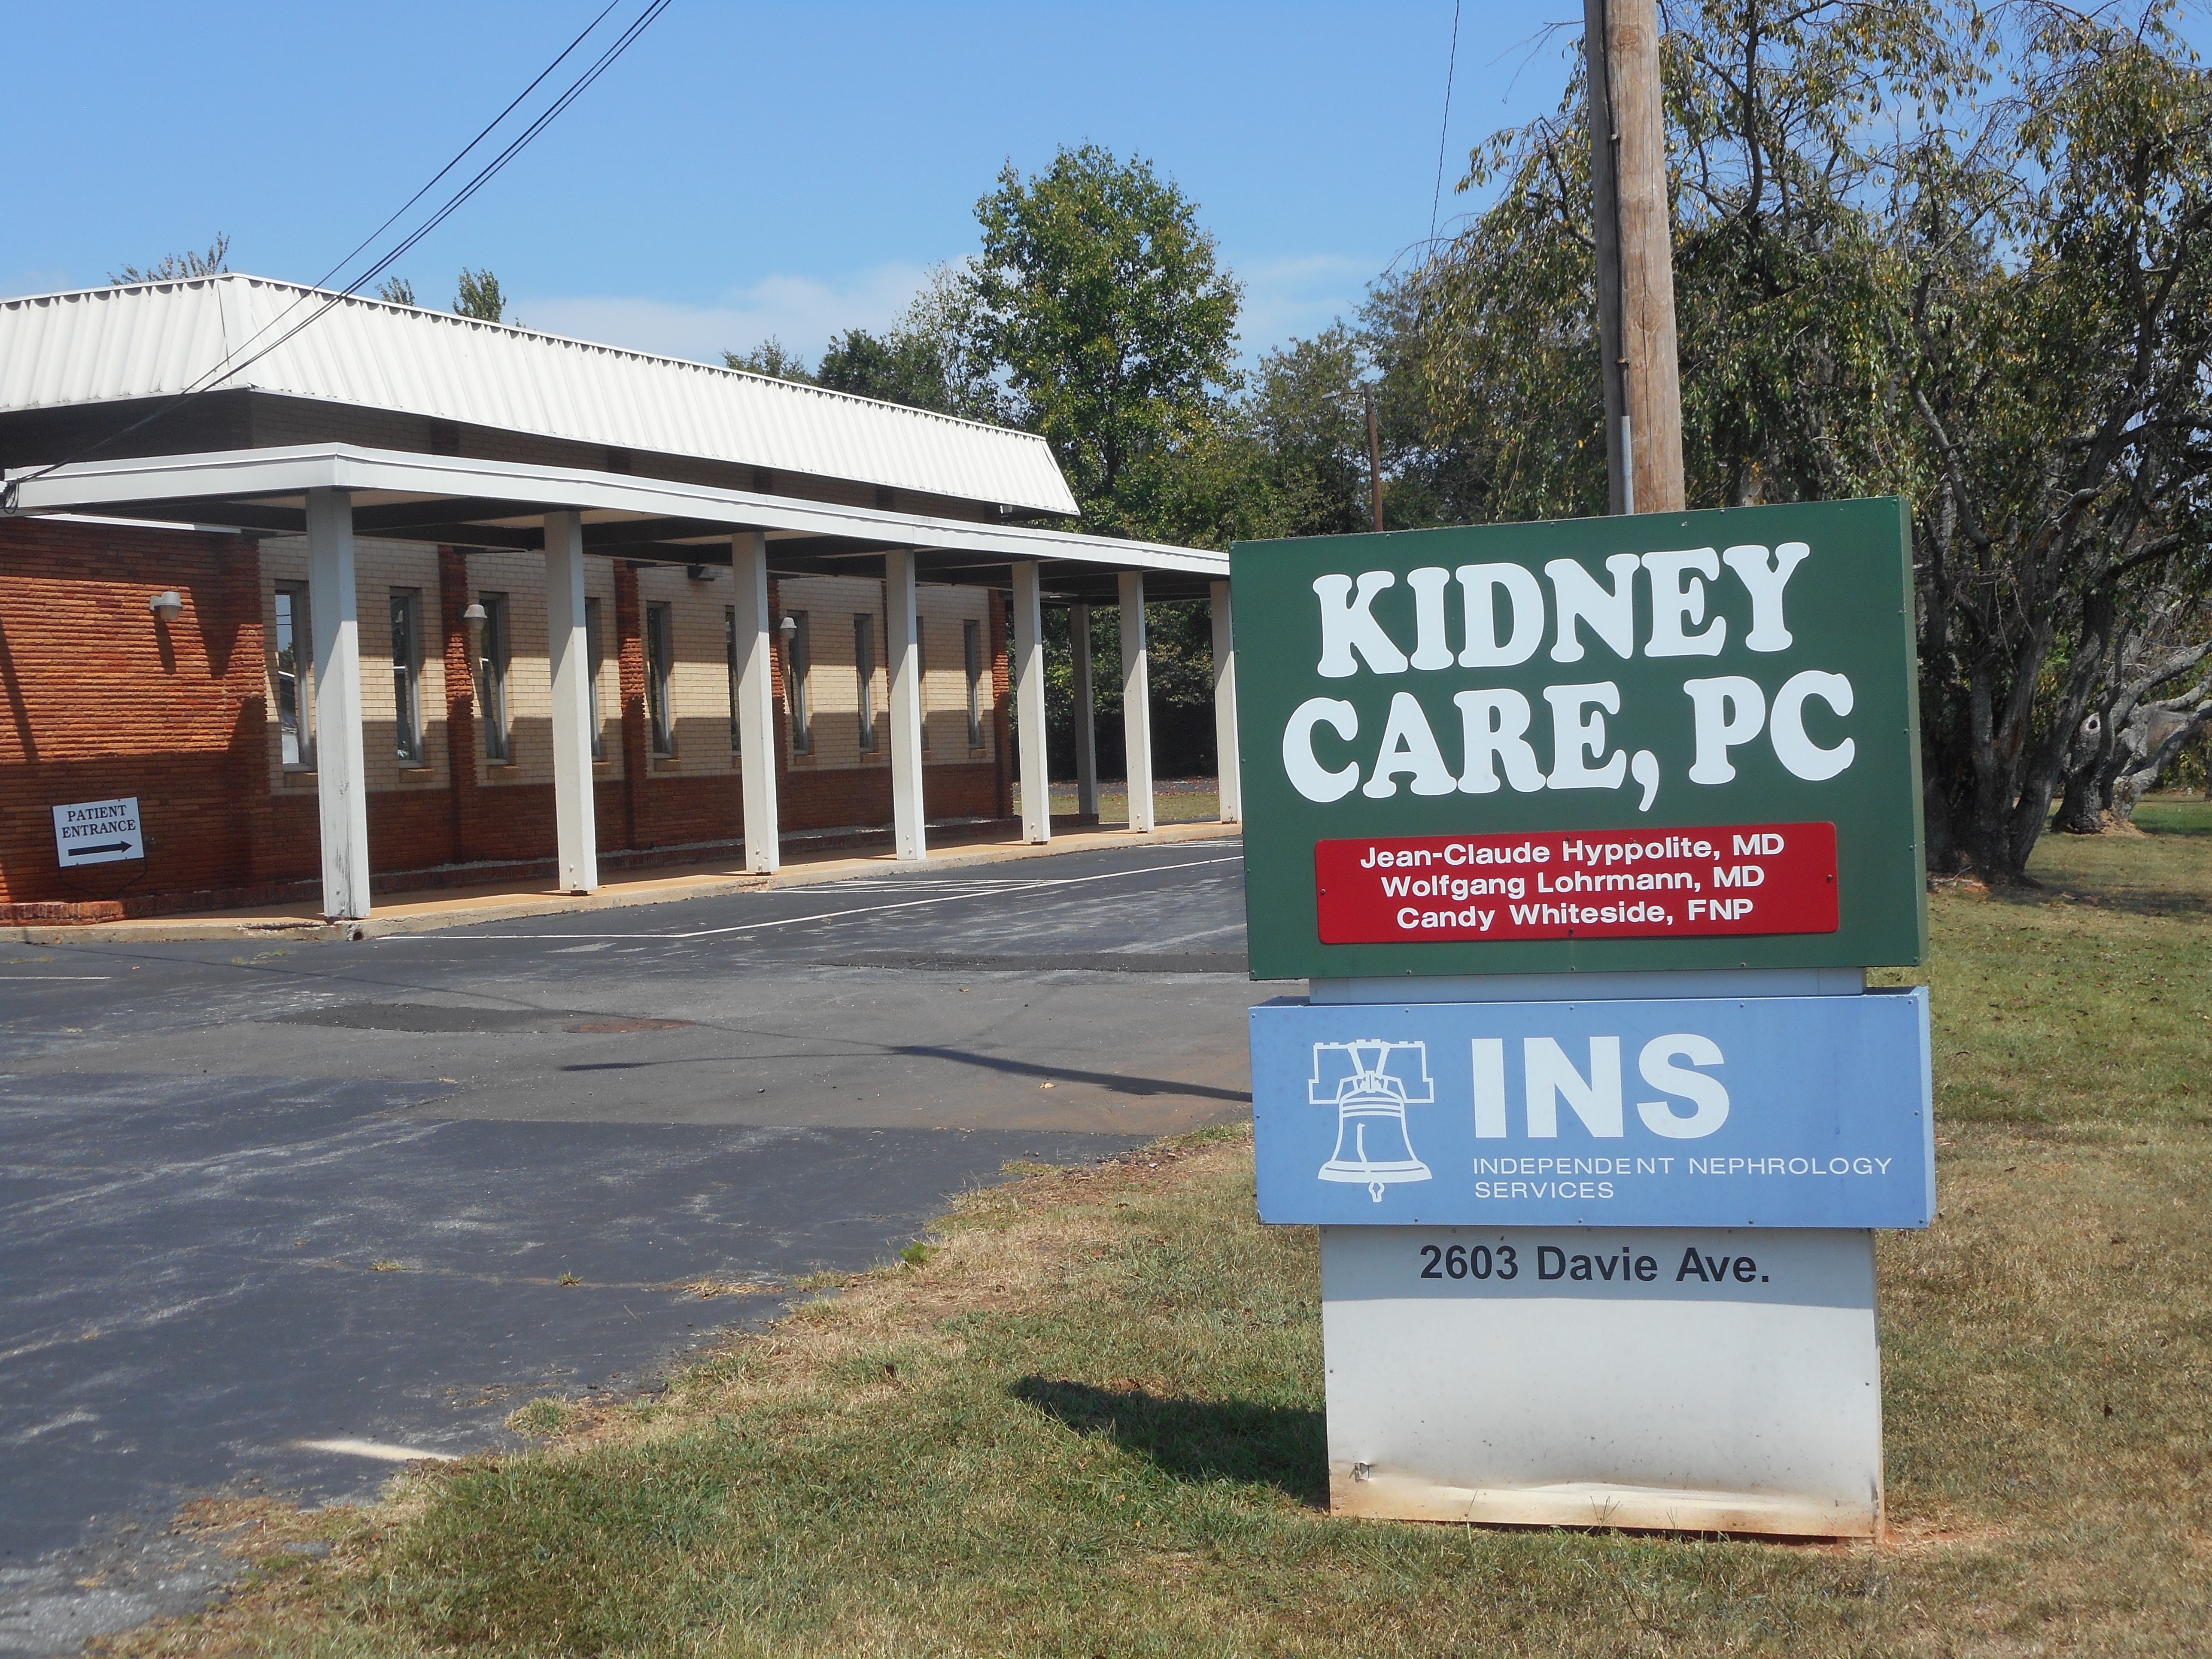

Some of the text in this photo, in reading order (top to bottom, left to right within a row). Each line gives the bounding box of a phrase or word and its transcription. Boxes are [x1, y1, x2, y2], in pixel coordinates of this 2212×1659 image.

[1313, 542, 1810, 678] KIDNEY
[1283, 670, 1855, 811] CARE, PC
[61, 819, 136, 838] ENTRANCE
[67, 805, 126, 822] PATIENT
[1361, 834, 1784, 868] Jean-Claude Hyppolite, MD
[1381, 866, 1764, 901] Wolfgang Lohrmann, MD
[1398, 899, 1753, 931] Candy Whiteside, FNP
[1472, 1034, 1729, 1139] INS
[1474, 1158, 1892, 1174] INDEPENDENT NEPHROLOGY
[1476, 1182, 1613, 1198] SERVICES
[1421, 1245, 1768, 1282] 2603 Davie Ave.
